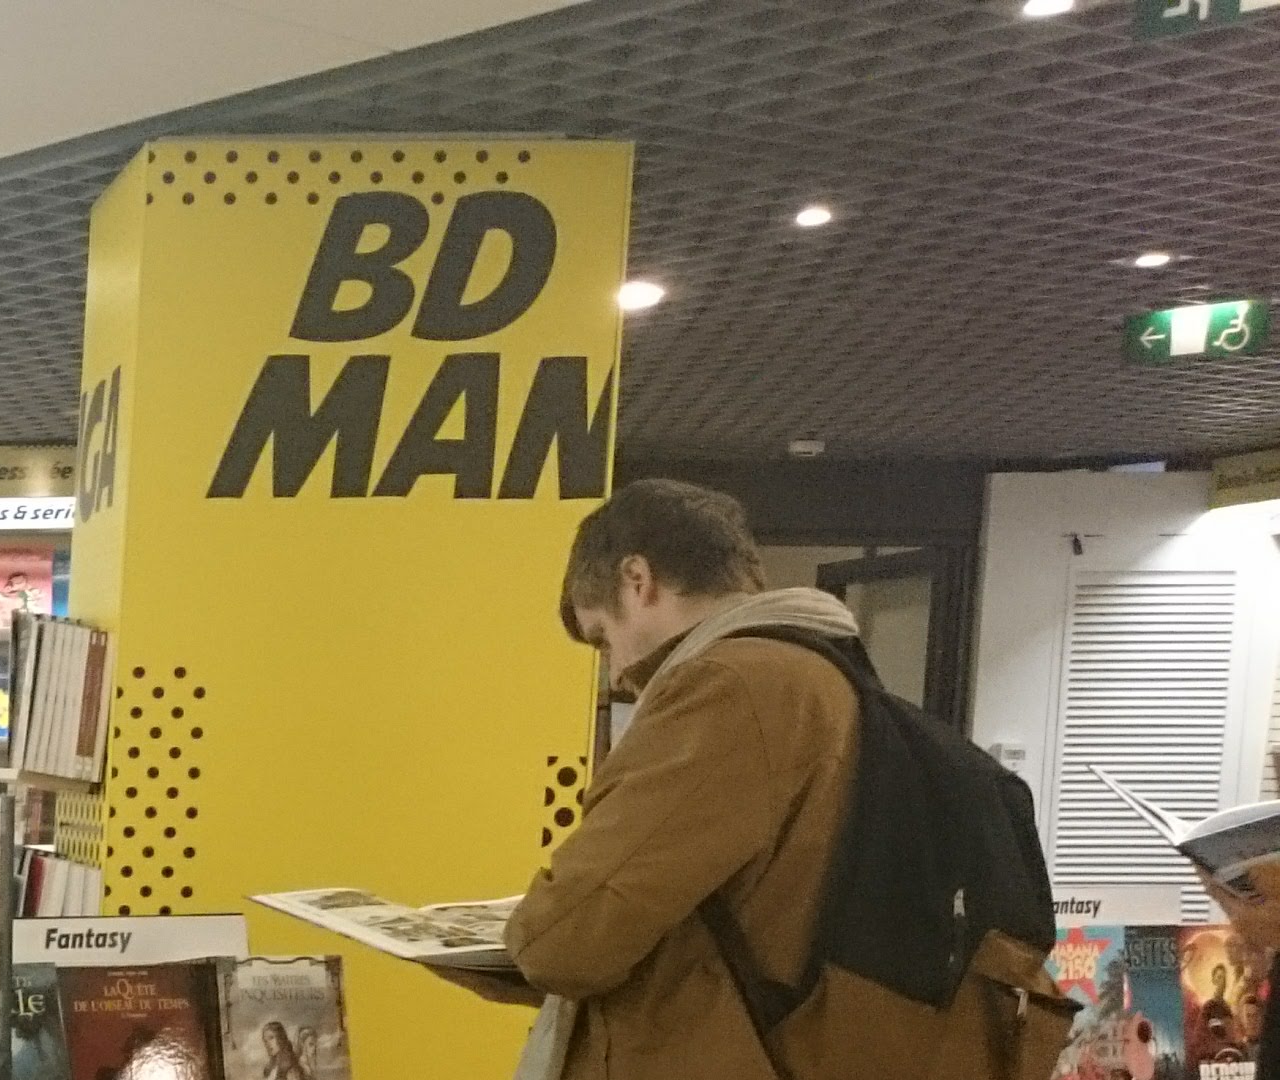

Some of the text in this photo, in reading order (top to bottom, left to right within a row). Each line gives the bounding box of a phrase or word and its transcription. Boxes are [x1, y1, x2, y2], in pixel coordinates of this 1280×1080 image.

[290, 191, 558, 342] BD
[13, 505, 29, 520] &
[1051, 897, 1102, 919] antasy
[45, 928, 133, 953] Fantasy
